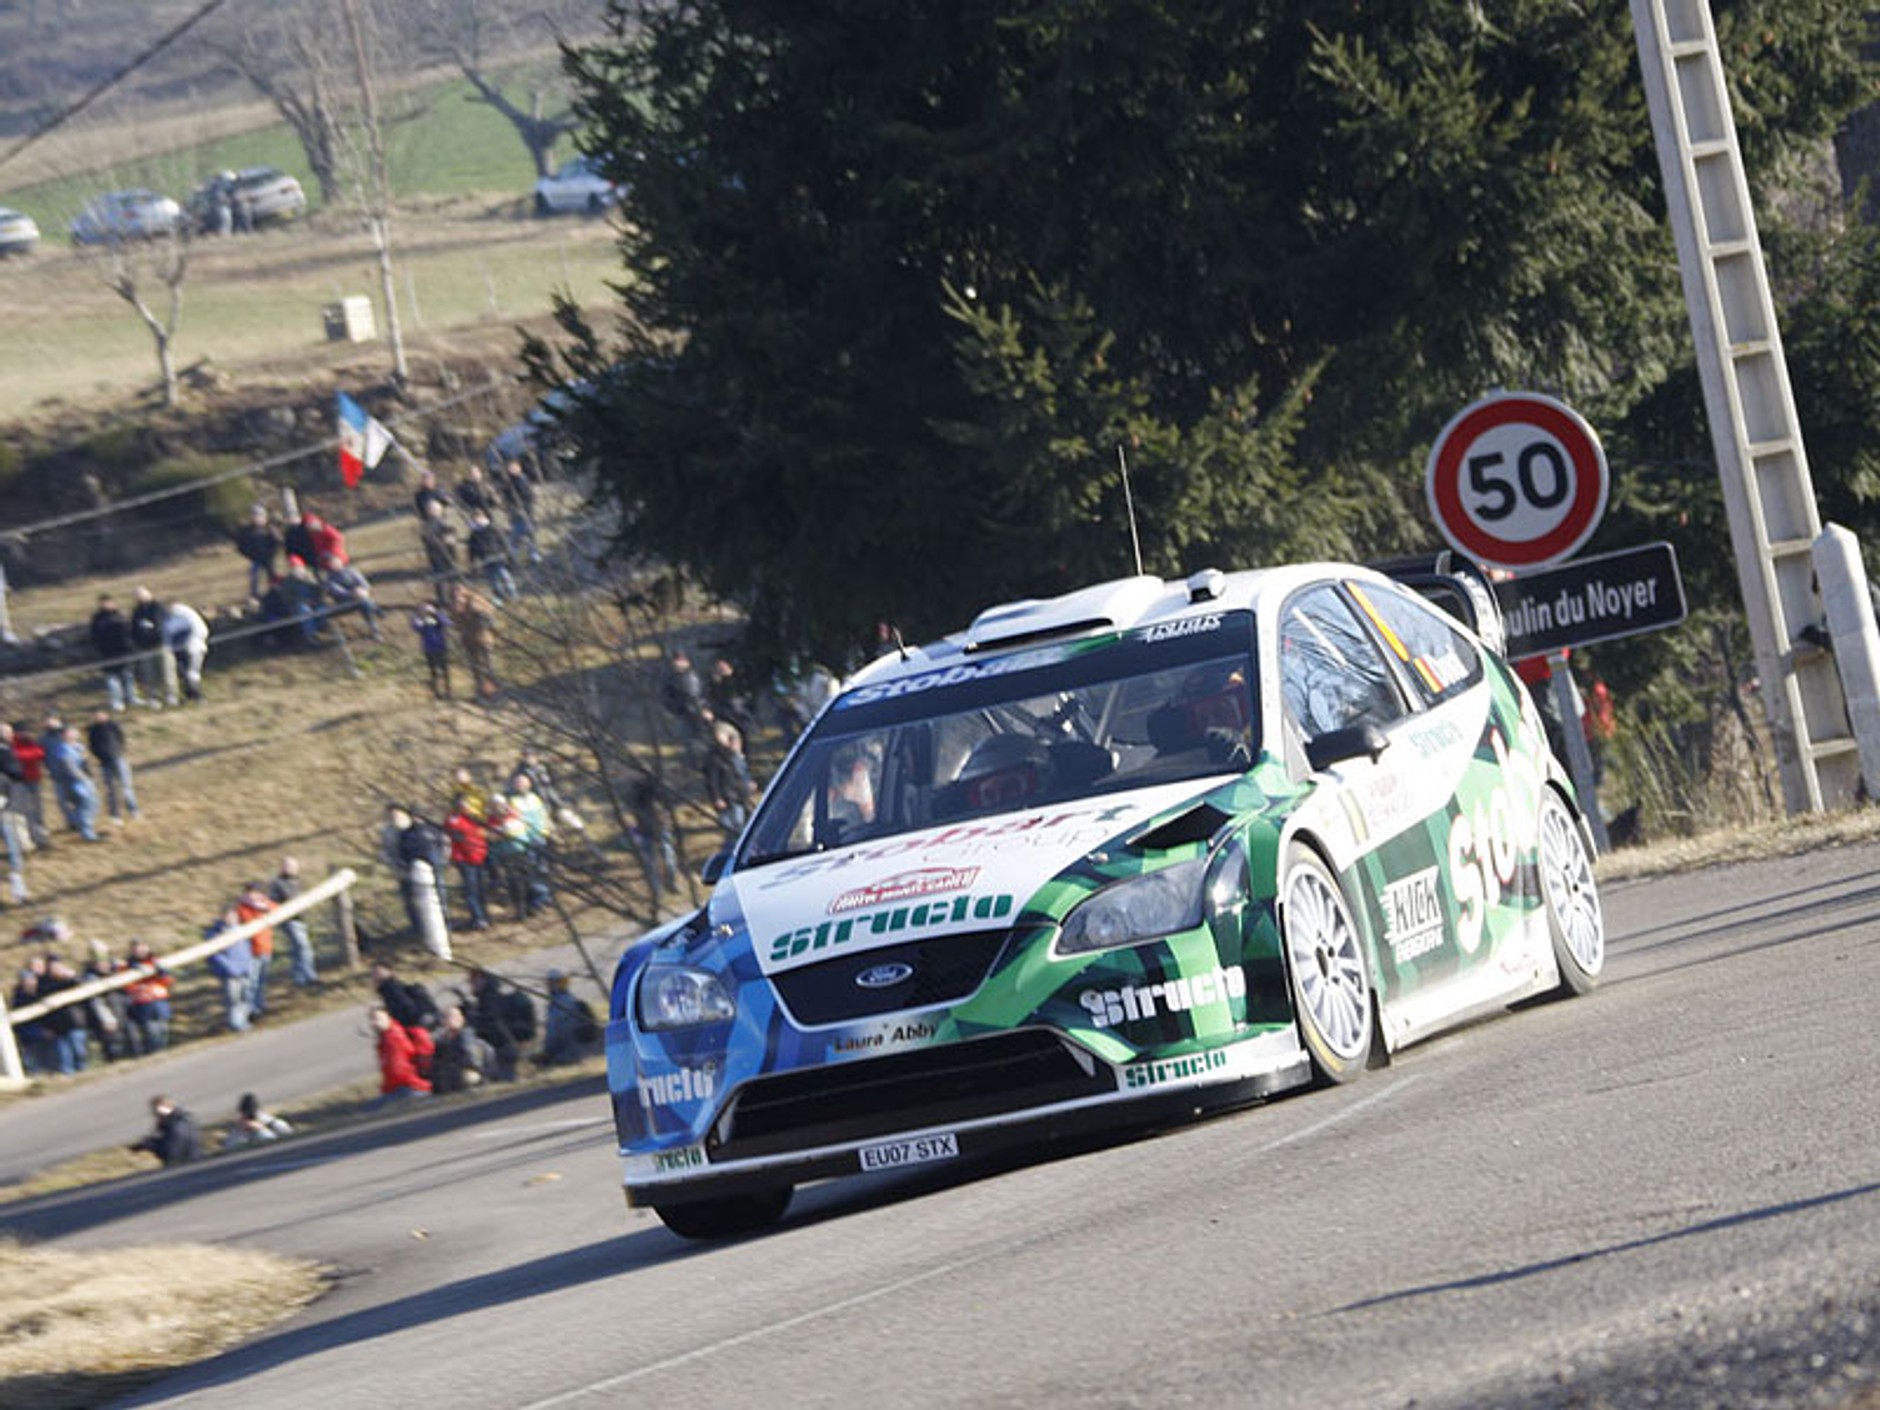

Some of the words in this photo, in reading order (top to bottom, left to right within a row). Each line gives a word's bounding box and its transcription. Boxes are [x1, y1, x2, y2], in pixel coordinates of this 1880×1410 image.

[1469, 441, 1569, 521] 50
[1555, 588, 1585, 627] du
[1587, 579, 1657, 620] Noyer
[1393, 877, 1439, 934] KICK
[834, 1033, 884, 1053] Laura
[890, 1022, 936, 1044] Abby
[864, 1143, 910, 1168] EU07
[916, 1136, 952, 1160] STX
